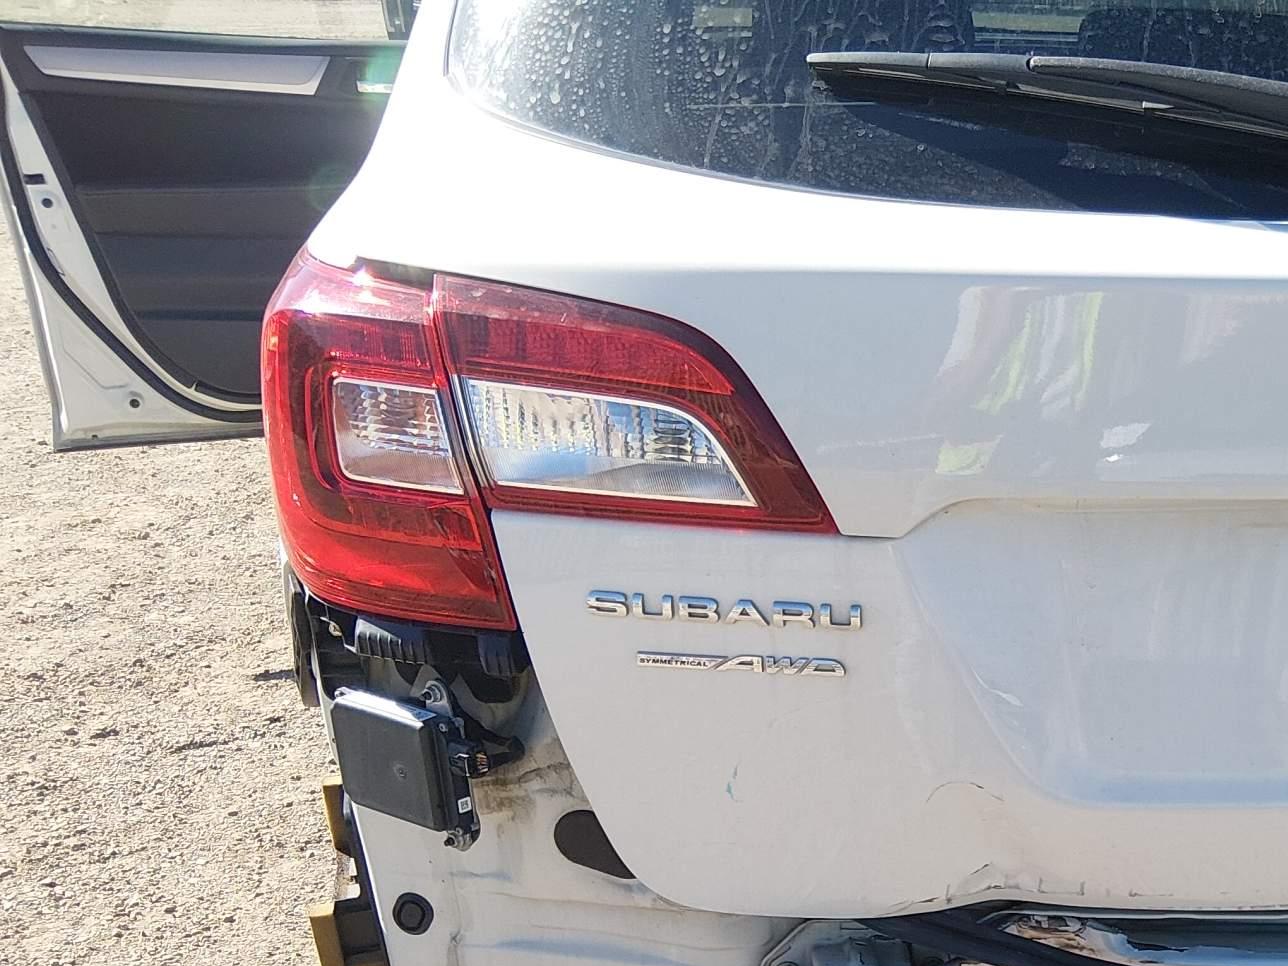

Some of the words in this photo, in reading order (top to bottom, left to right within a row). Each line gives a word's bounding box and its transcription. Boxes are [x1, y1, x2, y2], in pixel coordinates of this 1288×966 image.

[586, 589, 862, 631] SUBARU
[639, 657, 708, 667] SYMMETRICAL
[710, 654, 847, 677] AWD
